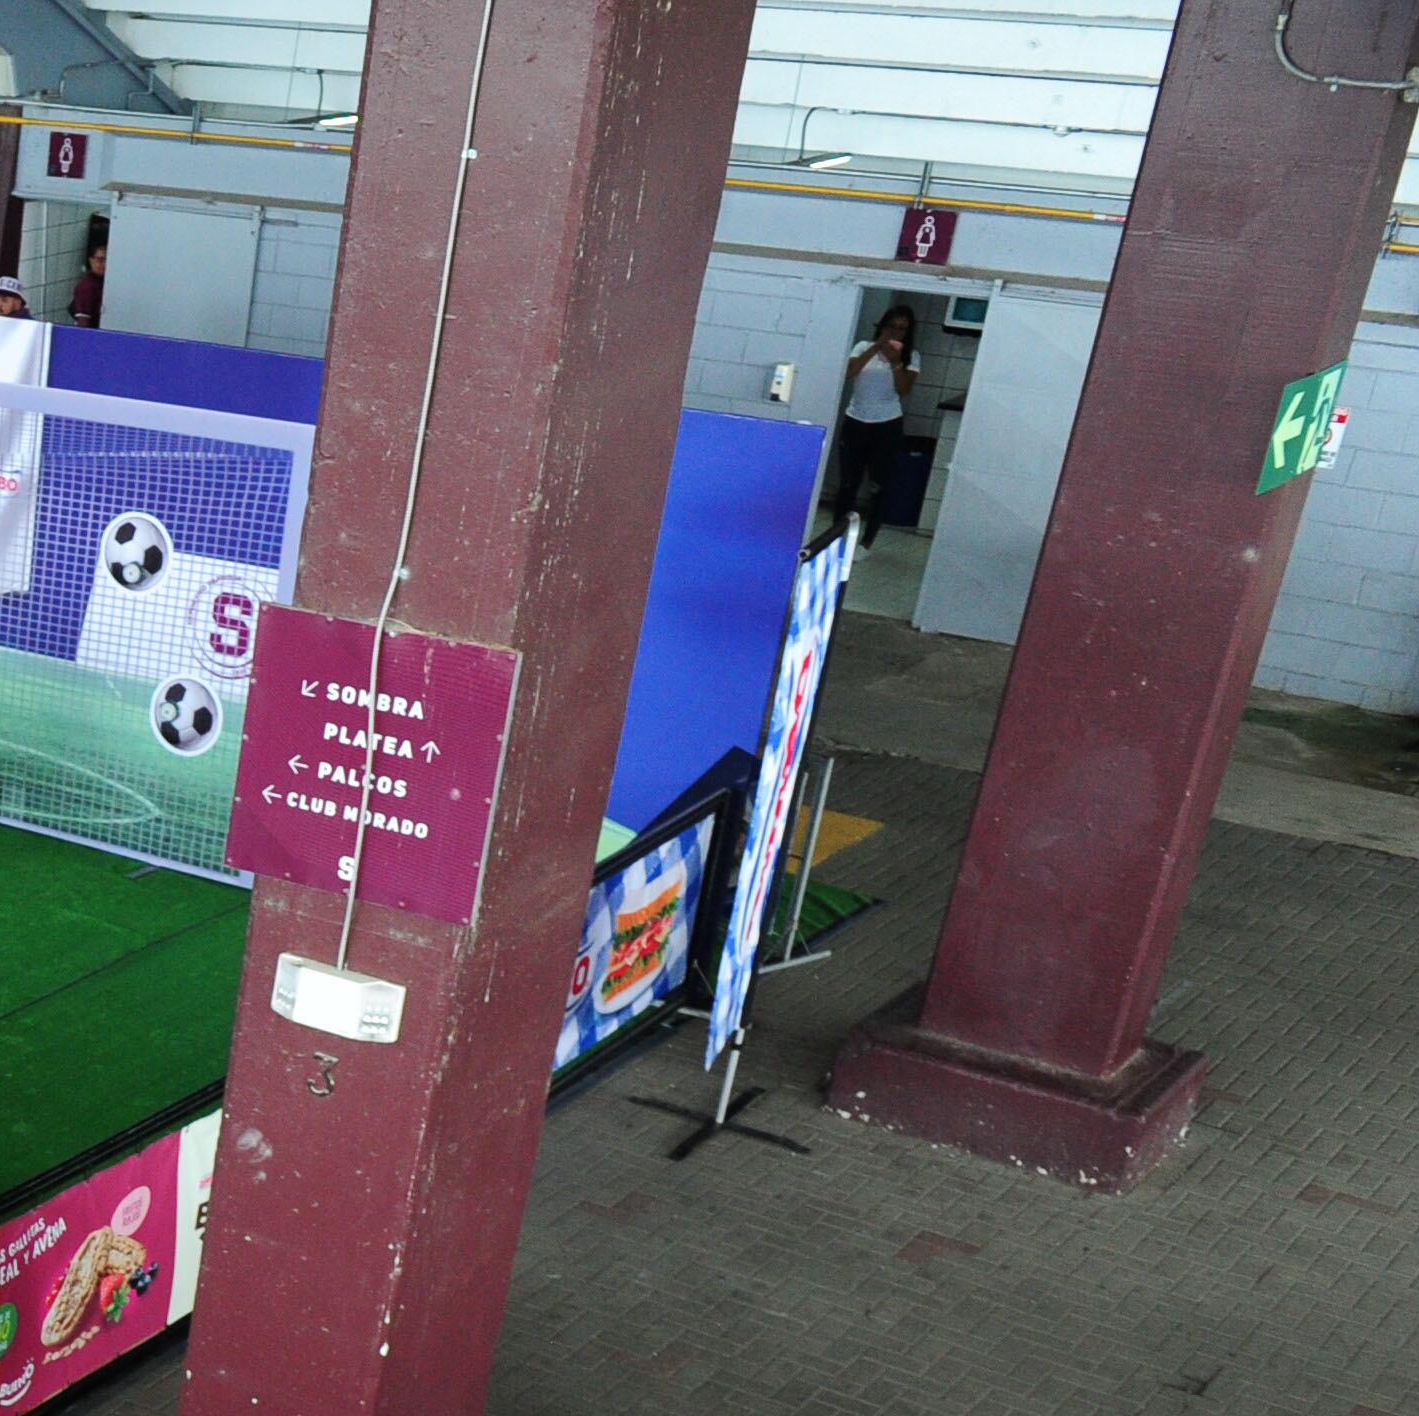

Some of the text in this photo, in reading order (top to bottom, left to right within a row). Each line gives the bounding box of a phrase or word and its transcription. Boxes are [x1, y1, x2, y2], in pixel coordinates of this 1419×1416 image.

[209, 592, 253, 658] S
[286, 790, 338, 819] CLUB
[307, 1051, 341, 1097] 3
[23, 1251, 31, 1265] Y
